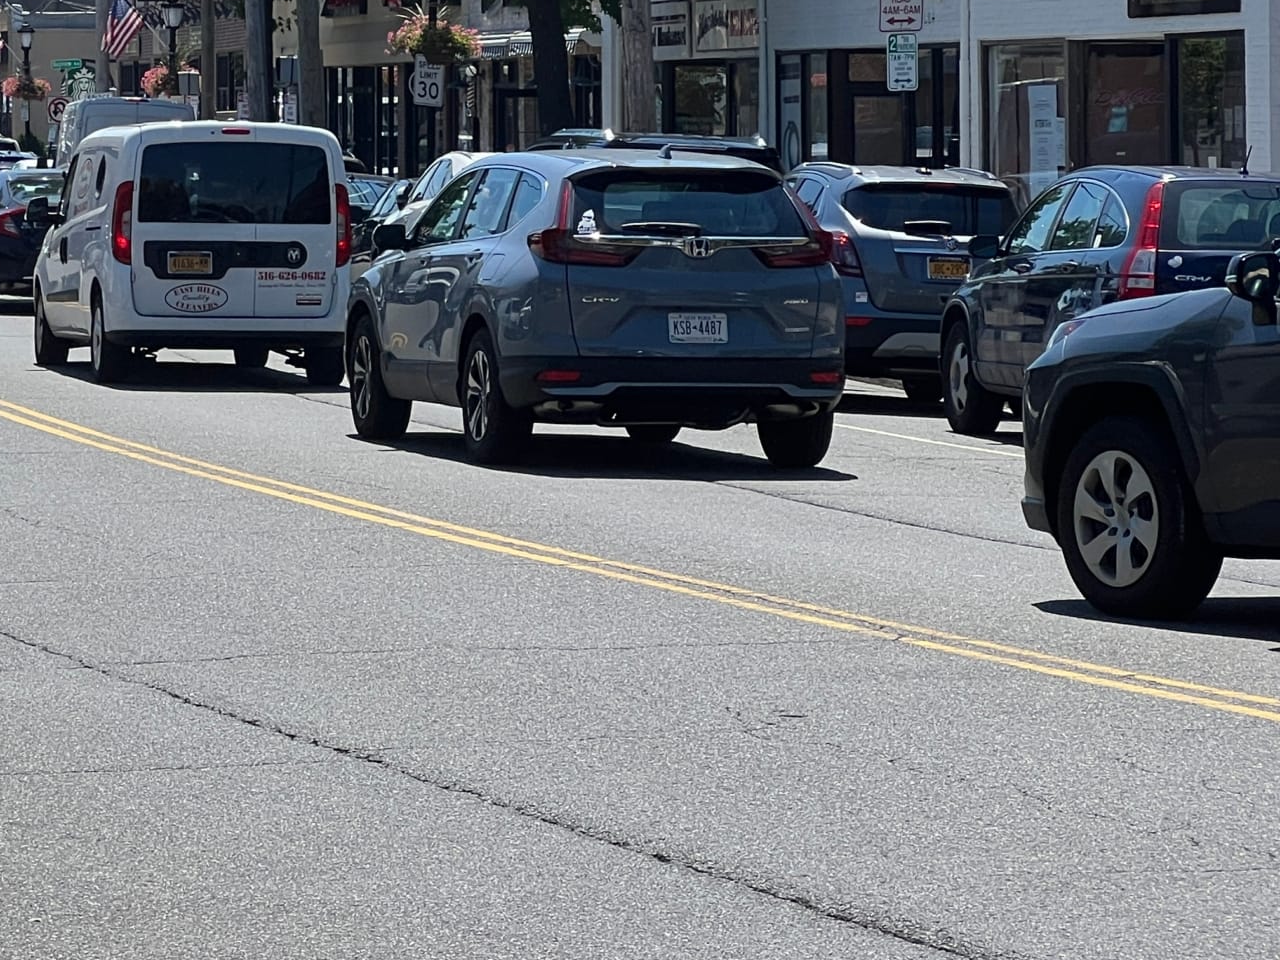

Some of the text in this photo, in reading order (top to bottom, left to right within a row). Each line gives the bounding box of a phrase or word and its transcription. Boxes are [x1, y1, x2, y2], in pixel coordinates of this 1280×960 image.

[882, 5, 921, 15] 4AM-6AM
[889, 36, 897, 51] 2
[419, 71, 439, 79] LIMIT
[417, 81, 439, 99] 30
[257, 271, 326, 281] 516-626-0682
[174, 285, 221, 297] EAST HILLS
[581, 295, 620, 303] CR-V
[175, 301, 219, 312] CLEANERS
